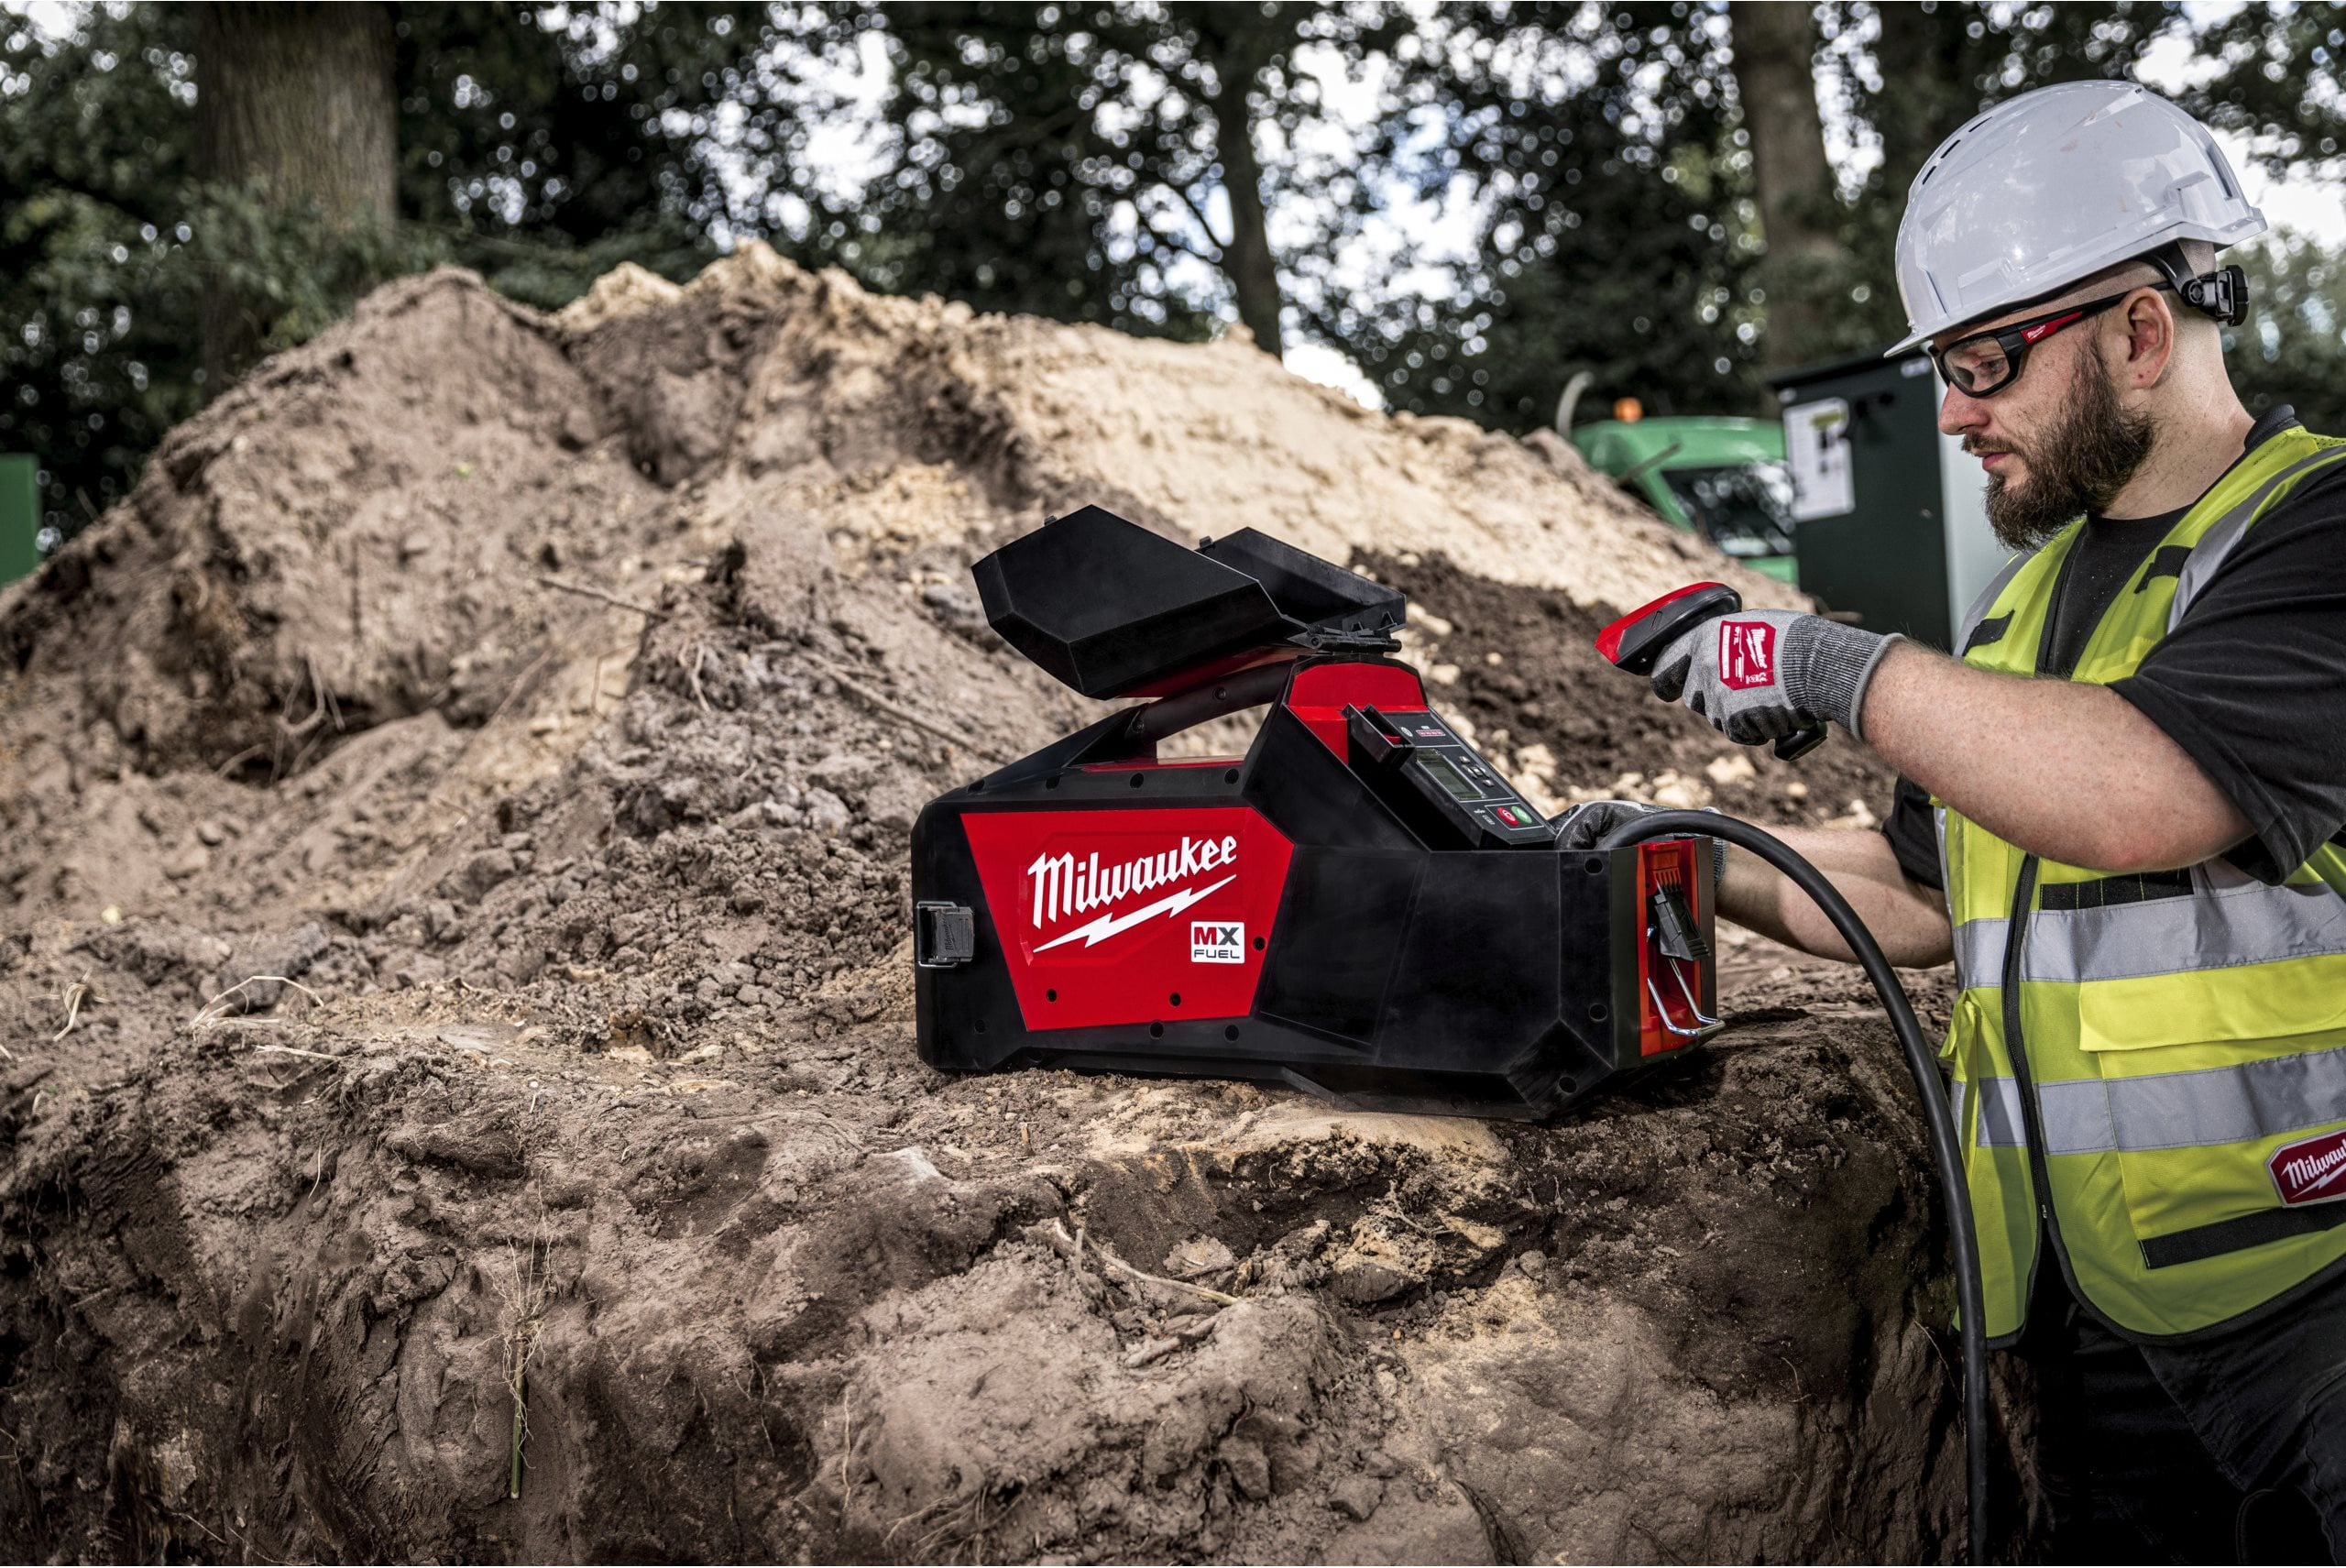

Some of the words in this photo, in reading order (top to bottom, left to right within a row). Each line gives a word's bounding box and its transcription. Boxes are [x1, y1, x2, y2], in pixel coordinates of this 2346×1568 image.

[1027, 835, 1237, 929] Milwaukee
[1193, 926, 1240, 946] MX
[1193, 949, 1241, 959] FUEL
